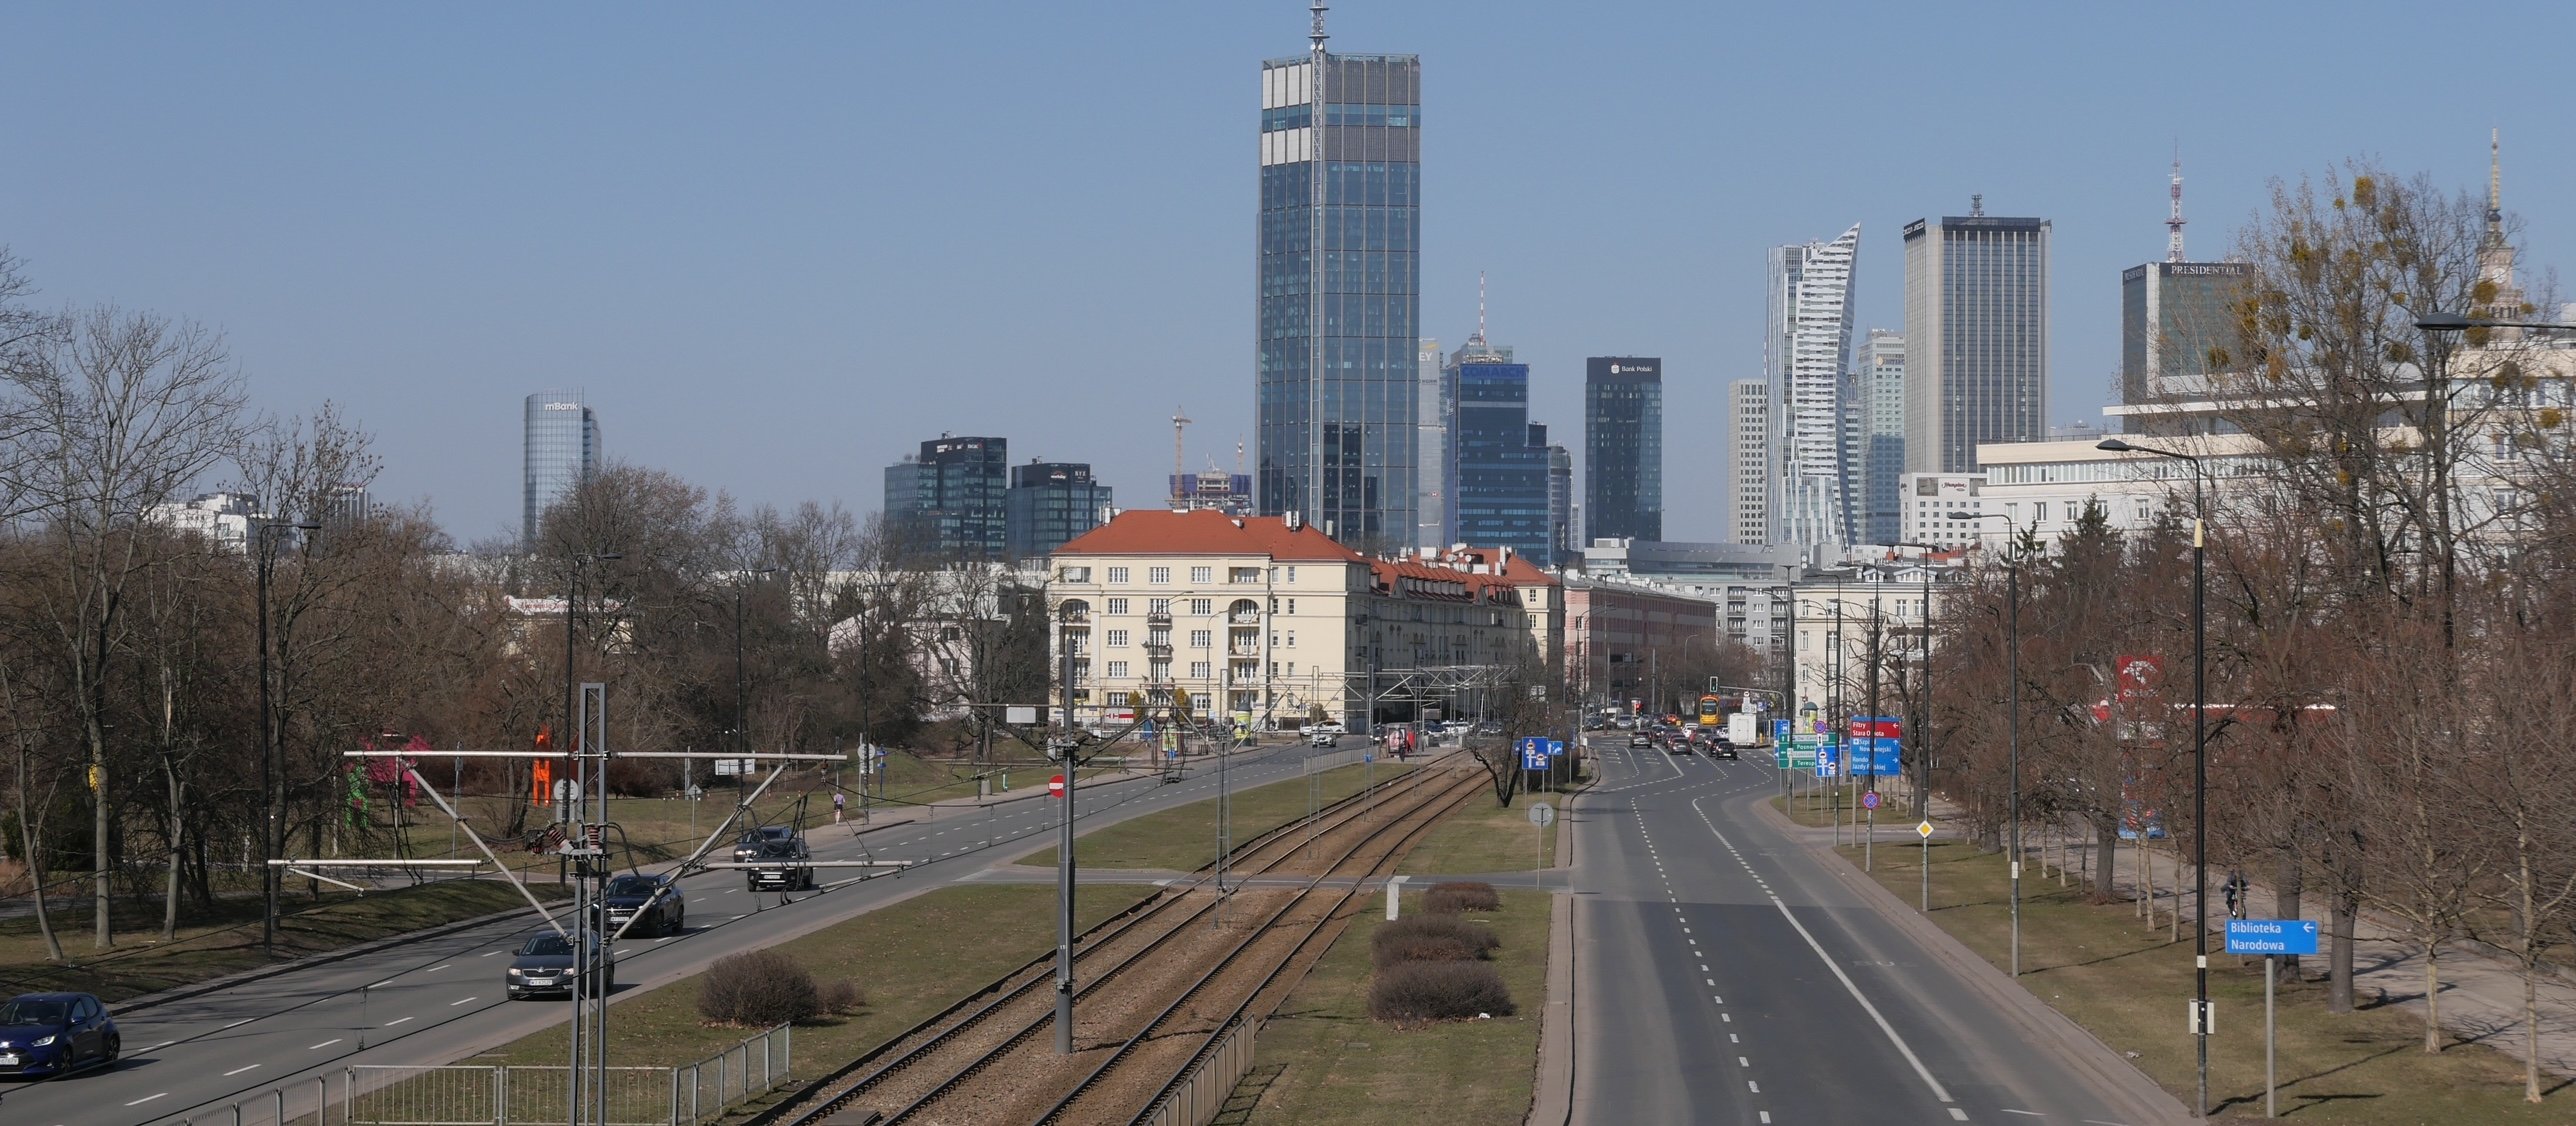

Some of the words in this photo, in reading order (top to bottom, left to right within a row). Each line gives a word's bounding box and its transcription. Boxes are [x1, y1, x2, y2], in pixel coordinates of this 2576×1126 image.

[2171, 265, 2241, 275] PRESIDENTIAL
[1418, 352, 1432, 361] EY
[1462, 366, 1527, 377] COMARCH
[545, 401, 578, 411] mBank
[2231, 922, 2281, 933] Biblioteka
[2231, 939, 2285, 950] Narodowa
